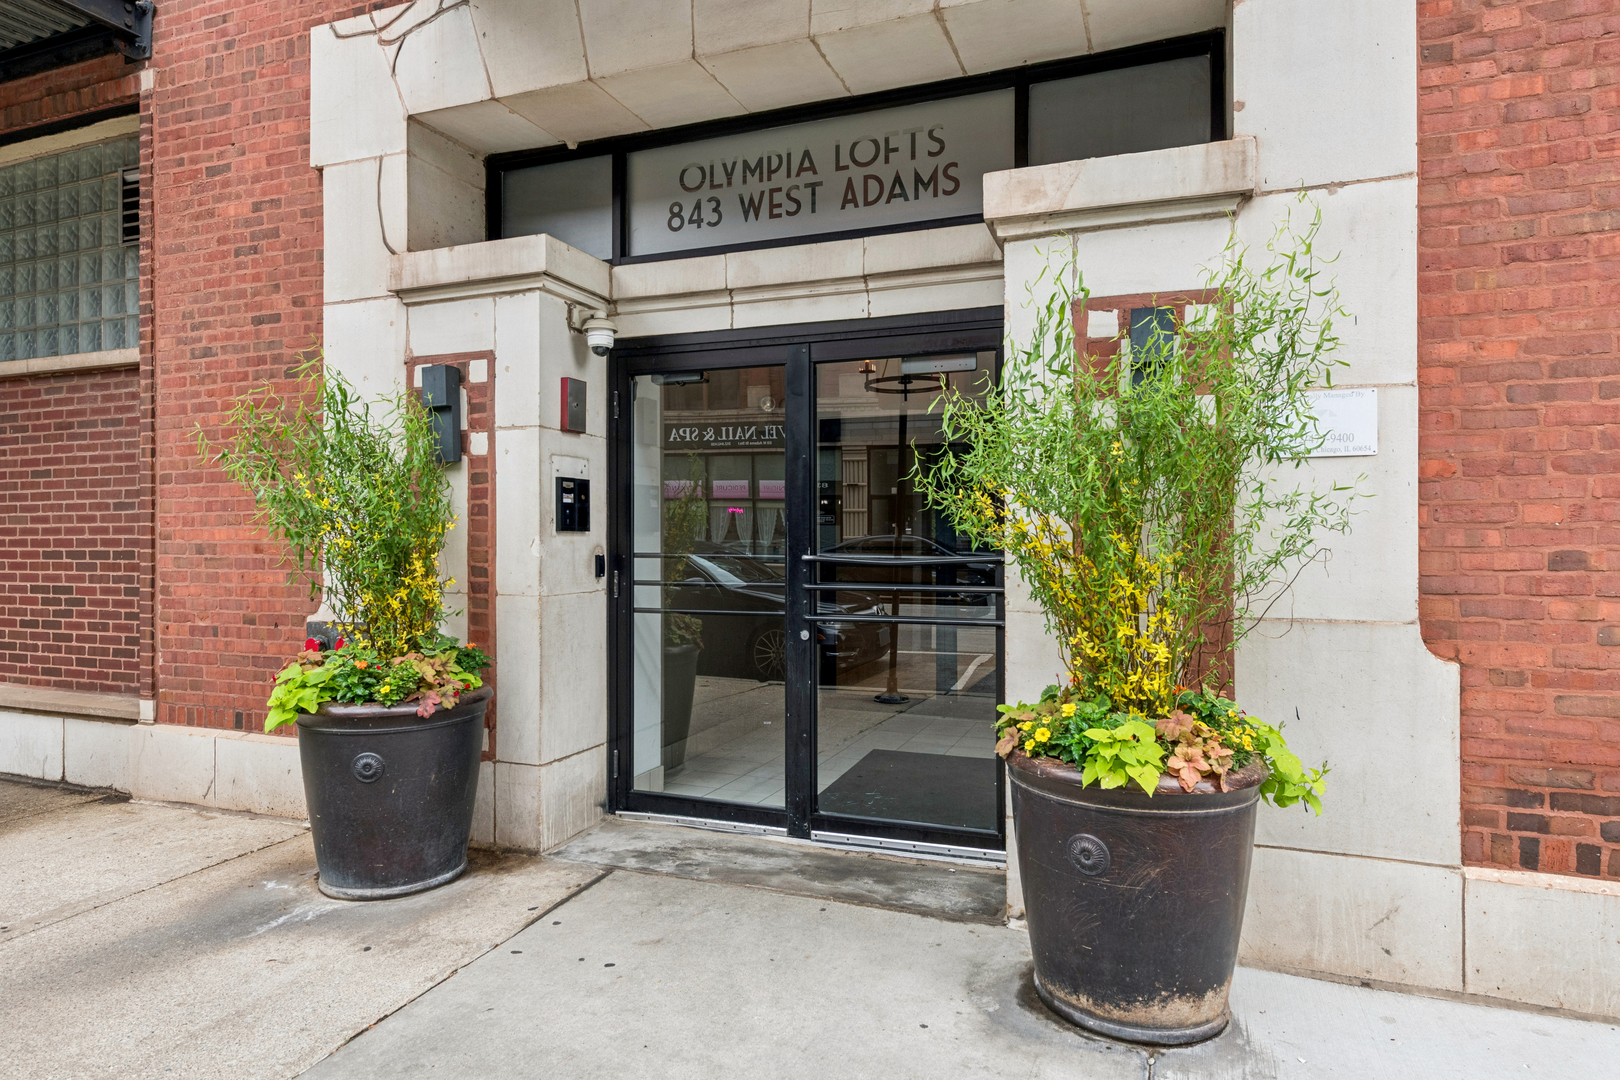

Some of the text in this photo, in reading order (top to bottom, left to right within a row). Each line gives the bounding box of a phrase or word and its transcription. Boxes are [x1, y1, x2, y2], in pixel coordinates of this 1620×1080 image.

[678, 123, 946, 193] OLYMPIA LOFTS
[667, 161, 961, 232] 843 WEST ADAMS
[1323, 391, 1354, 399] Managed
[1355, 390, 1365, 399] By
